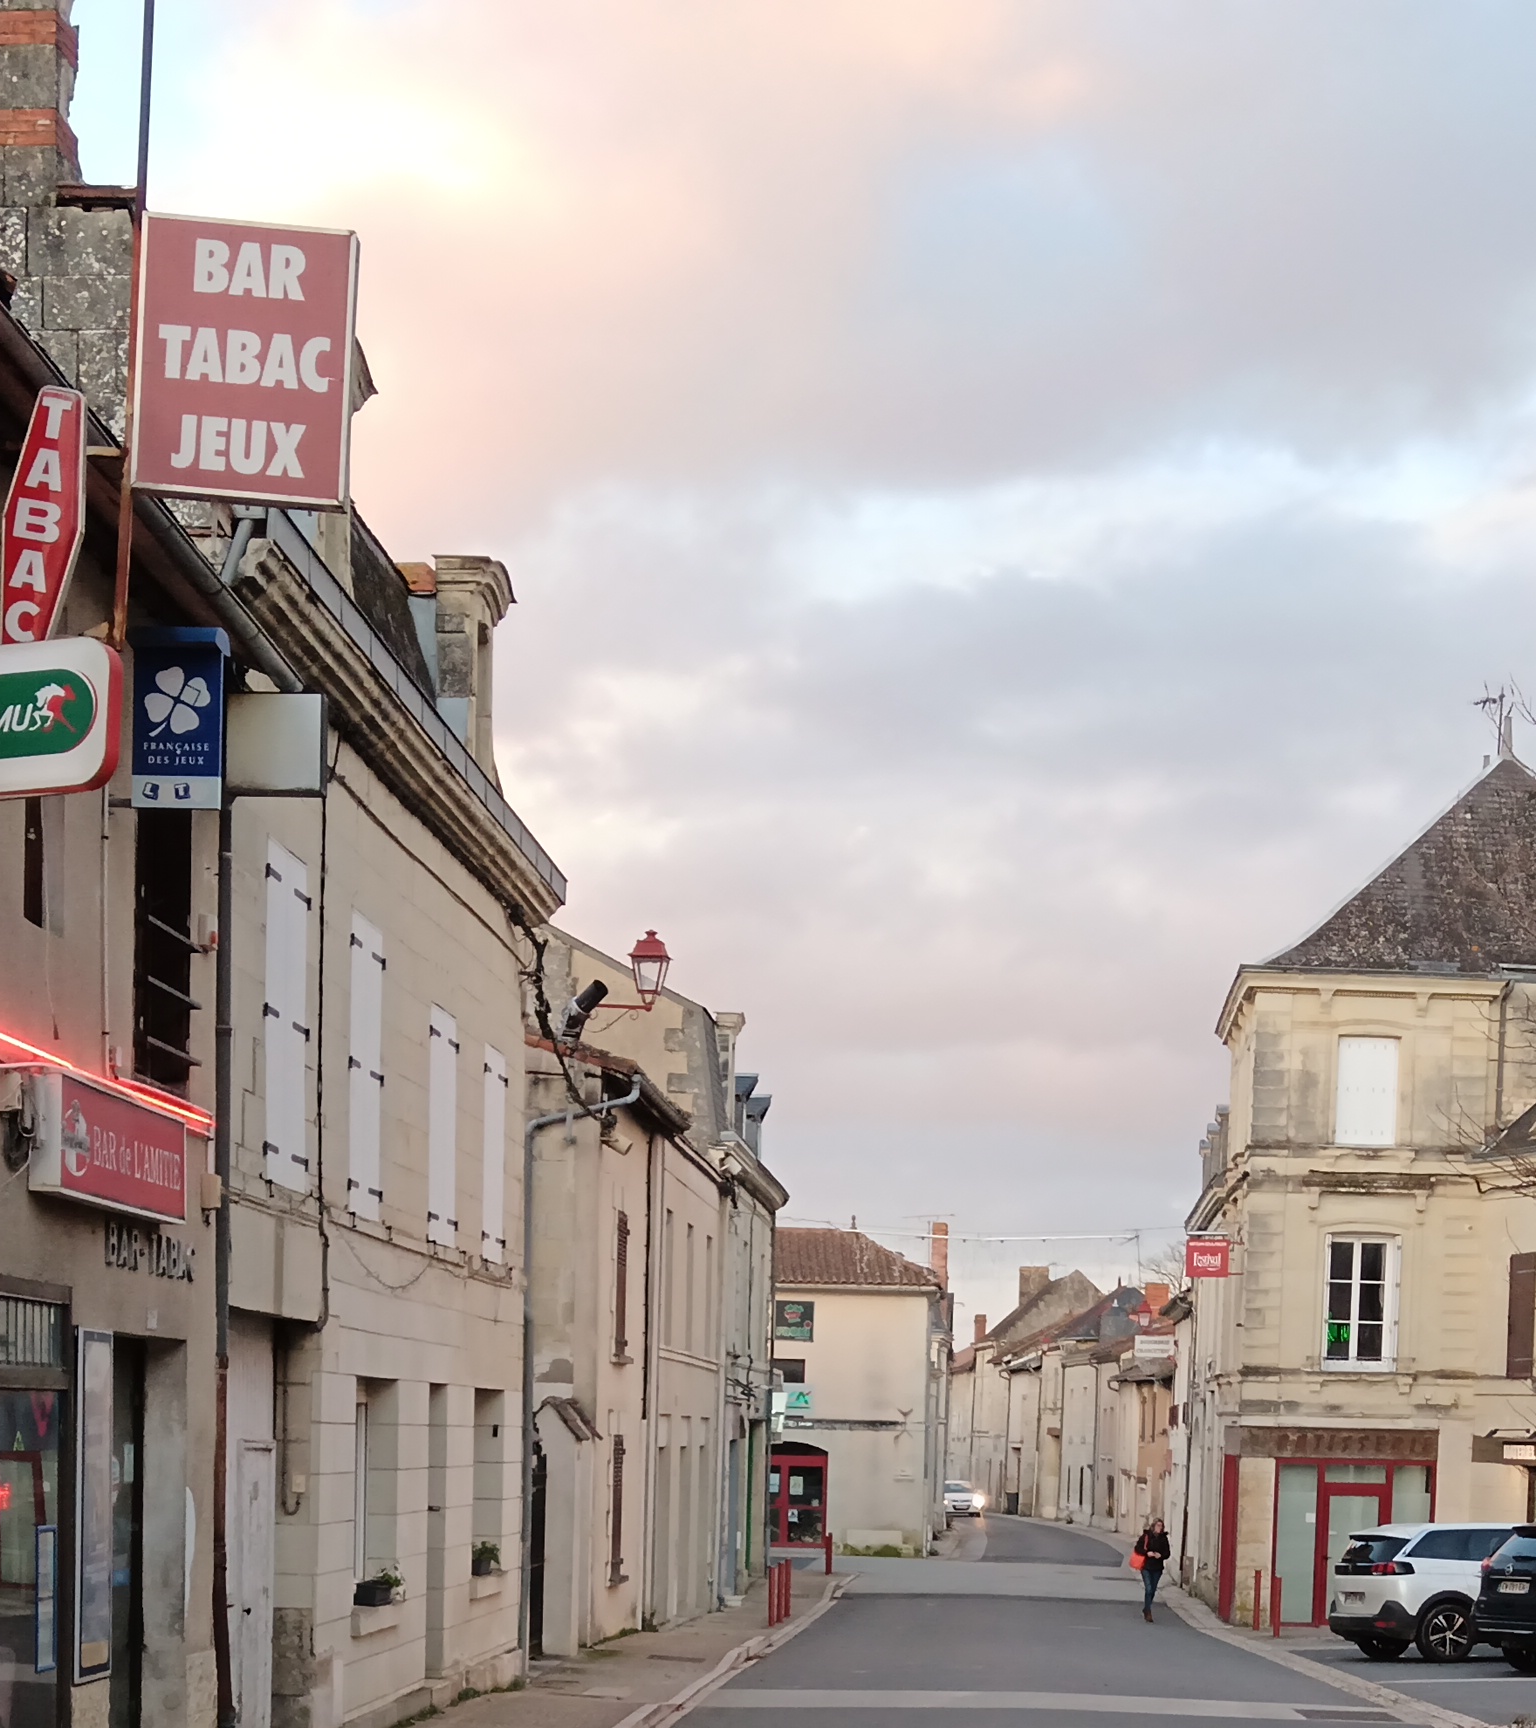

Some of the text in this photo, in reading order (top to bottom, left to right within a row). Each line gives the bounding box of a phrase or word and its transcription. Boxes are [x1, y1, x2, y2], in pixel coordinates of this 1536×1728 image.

[193, 238, 307, 301] BAR
[158, 323, 332, 393] TABAC
[170, 414, 307, 479] JEUX
[4, 396, 73, 643] TABAC
[143, 741, 210, 755] FRANÇAISE
[147, 755, 205, 766] DES JEUX
[92, 1125, 118, 1172] BAR
[118, 1135, 132, 1176] de
